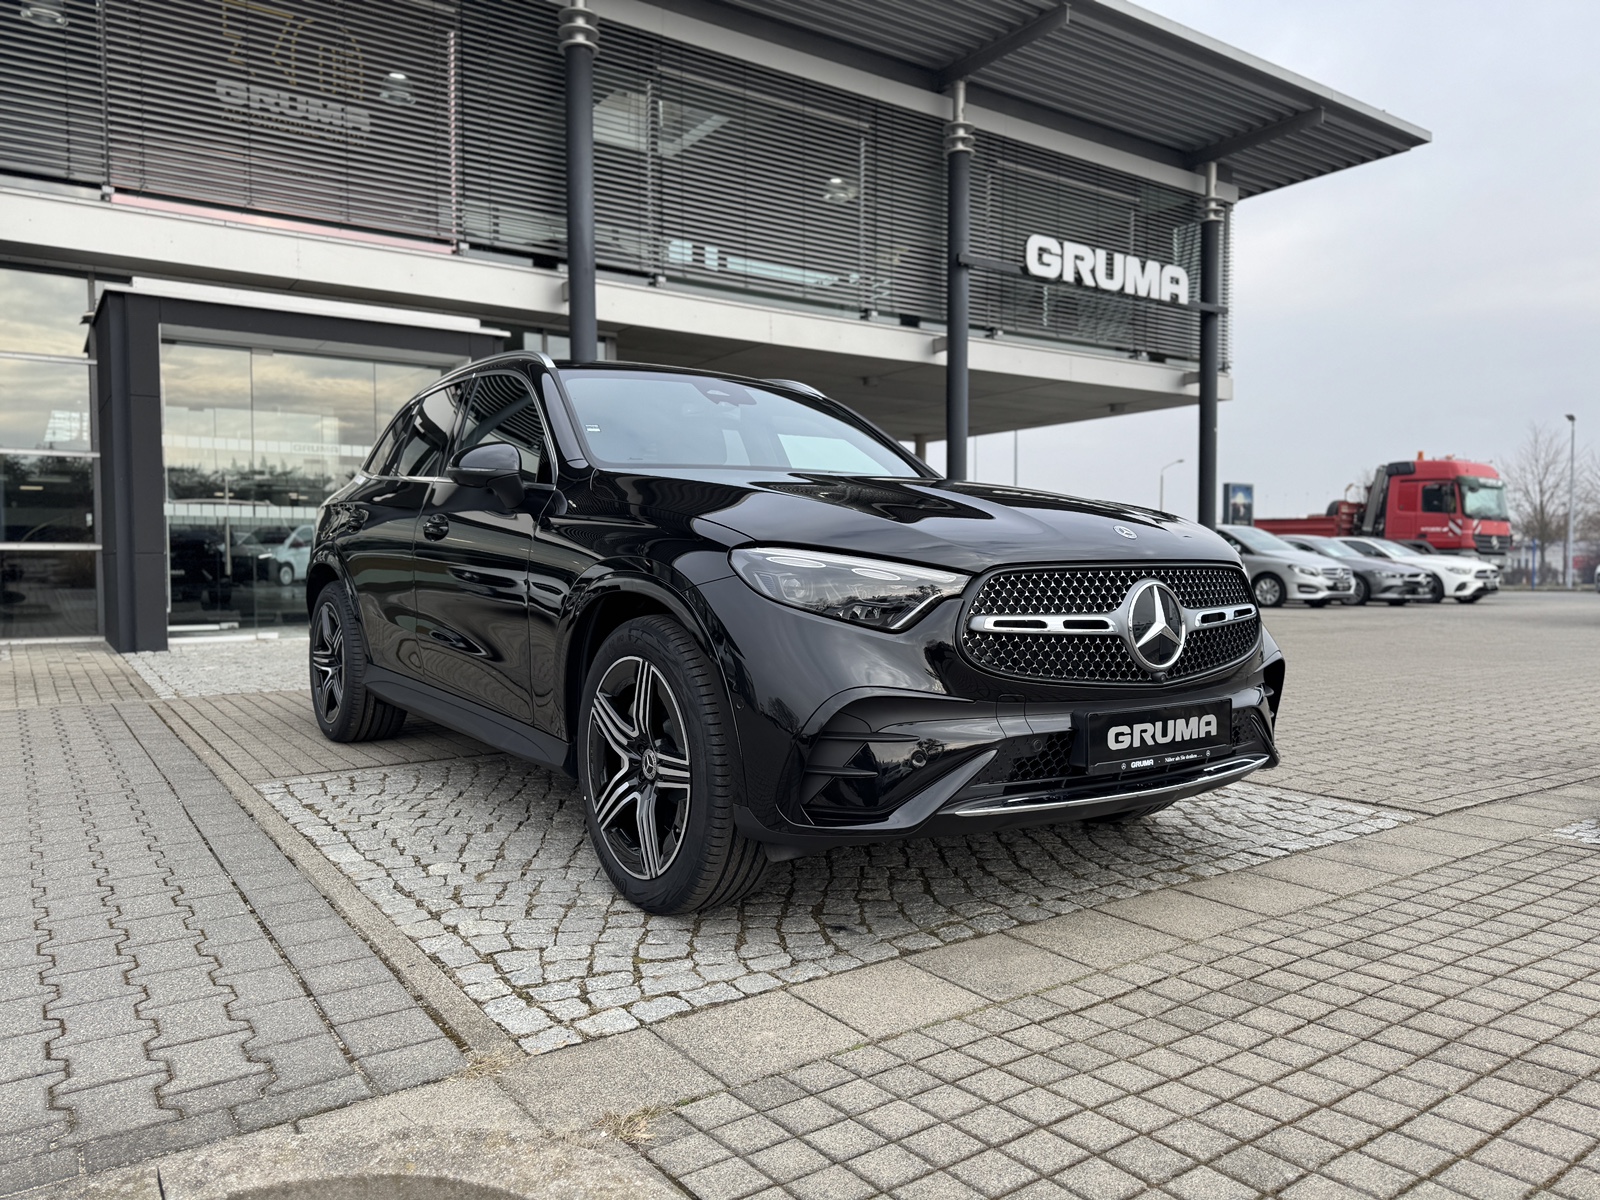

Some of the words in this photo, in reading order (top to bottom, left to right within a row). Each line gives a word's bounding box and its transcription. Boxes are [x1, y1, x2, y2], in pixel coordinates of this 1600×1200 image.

[215, 79, 371, 133] GRUMA
[1025, 234, 1189, 306] GRUMA
[1107, 714, 1217, 751] GRUMA
[1131, 759, 1154, 768] GRUMA
